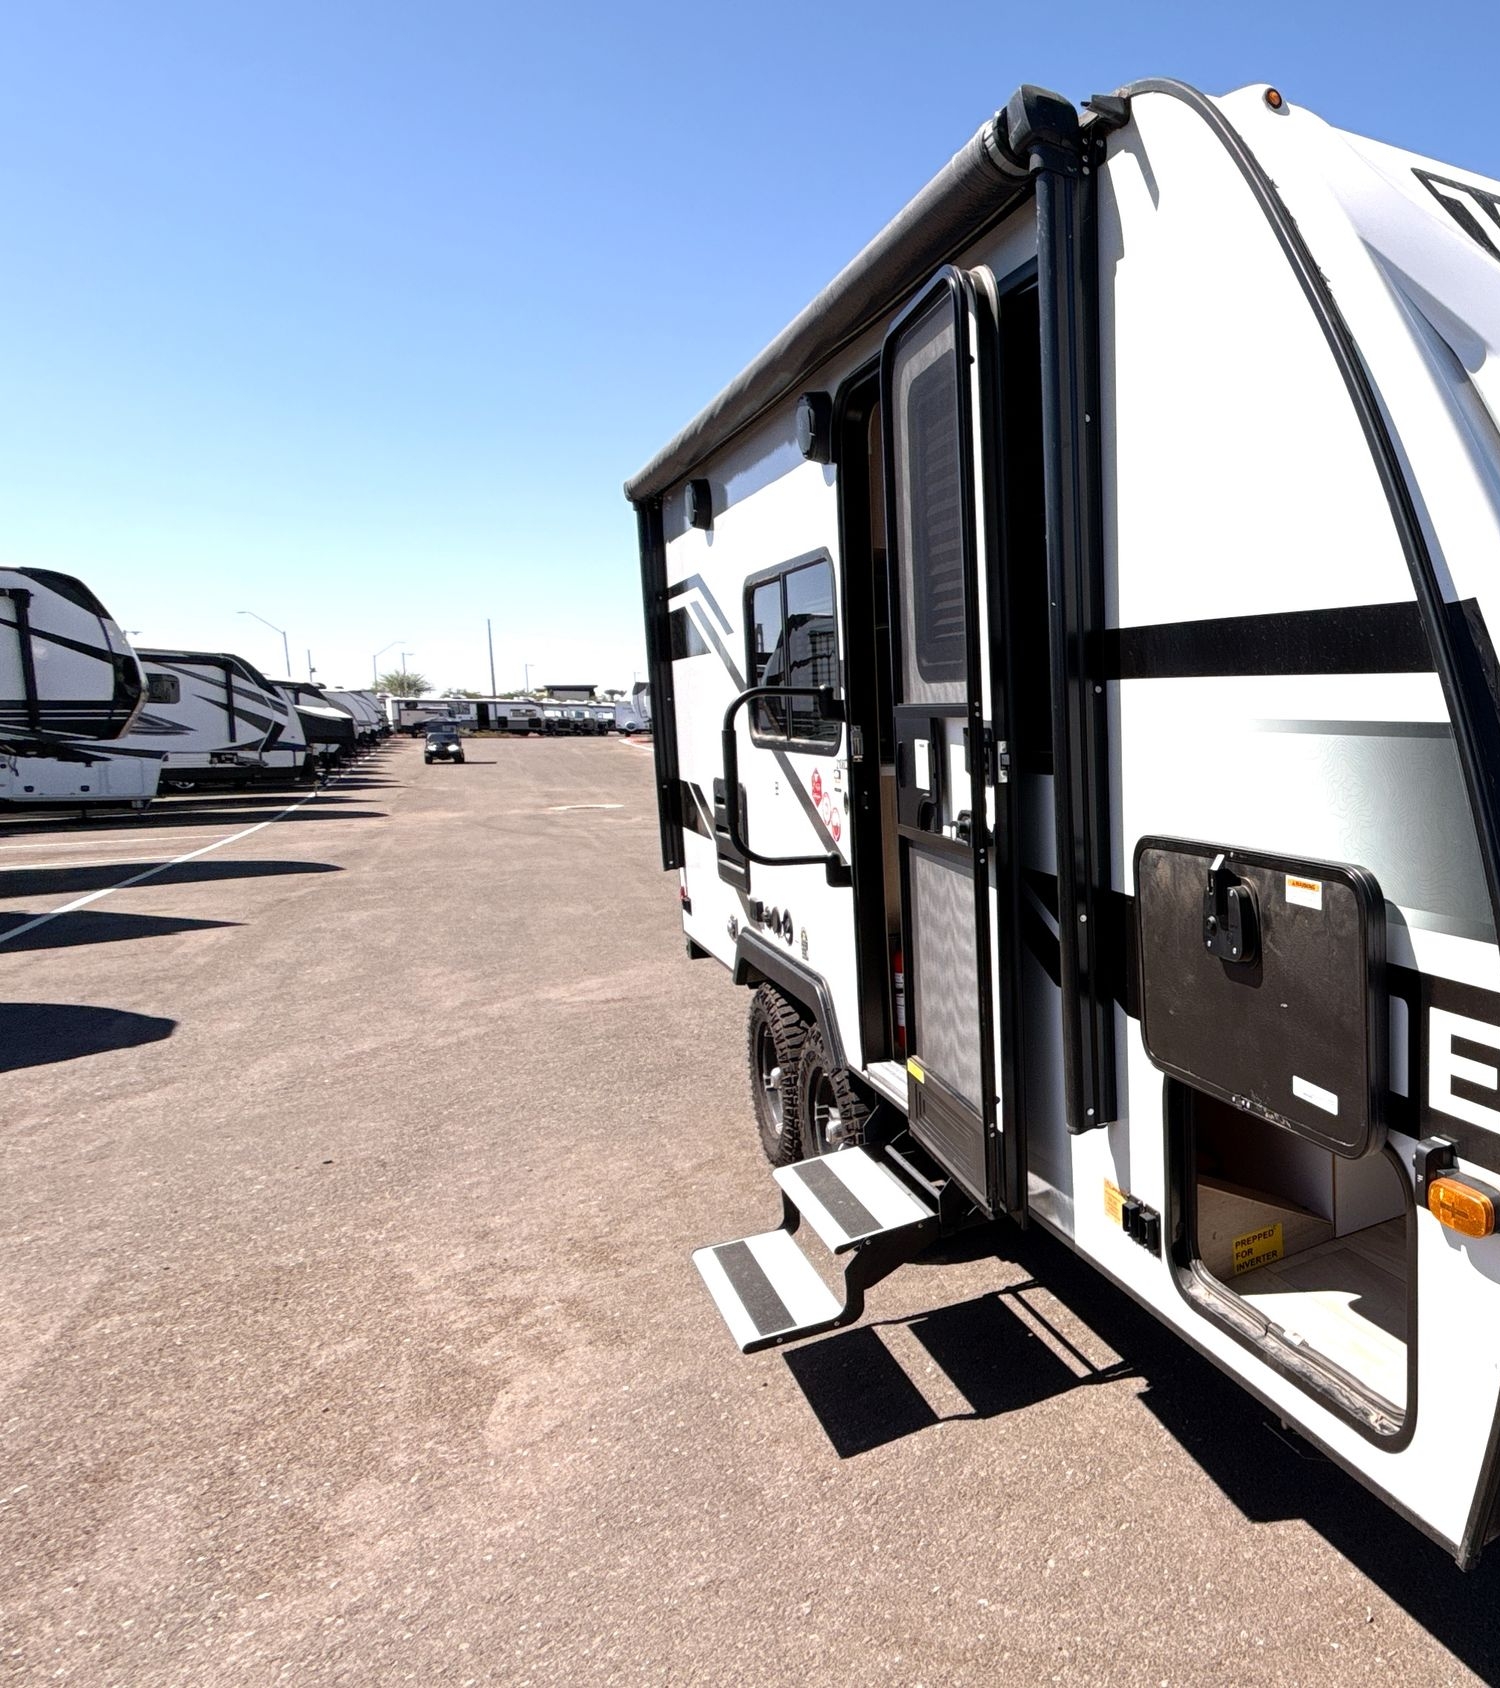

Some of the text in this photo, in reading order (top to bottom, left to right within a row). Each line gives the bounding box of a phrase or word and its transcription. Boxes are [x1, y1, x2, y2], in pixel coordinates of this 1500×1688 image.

[1235, 1229, 1274, 1249] PREPPED
[1236, 1247, 1253, 1261] FOR
[1237, 1249, 1278, 1273] INVERTER
